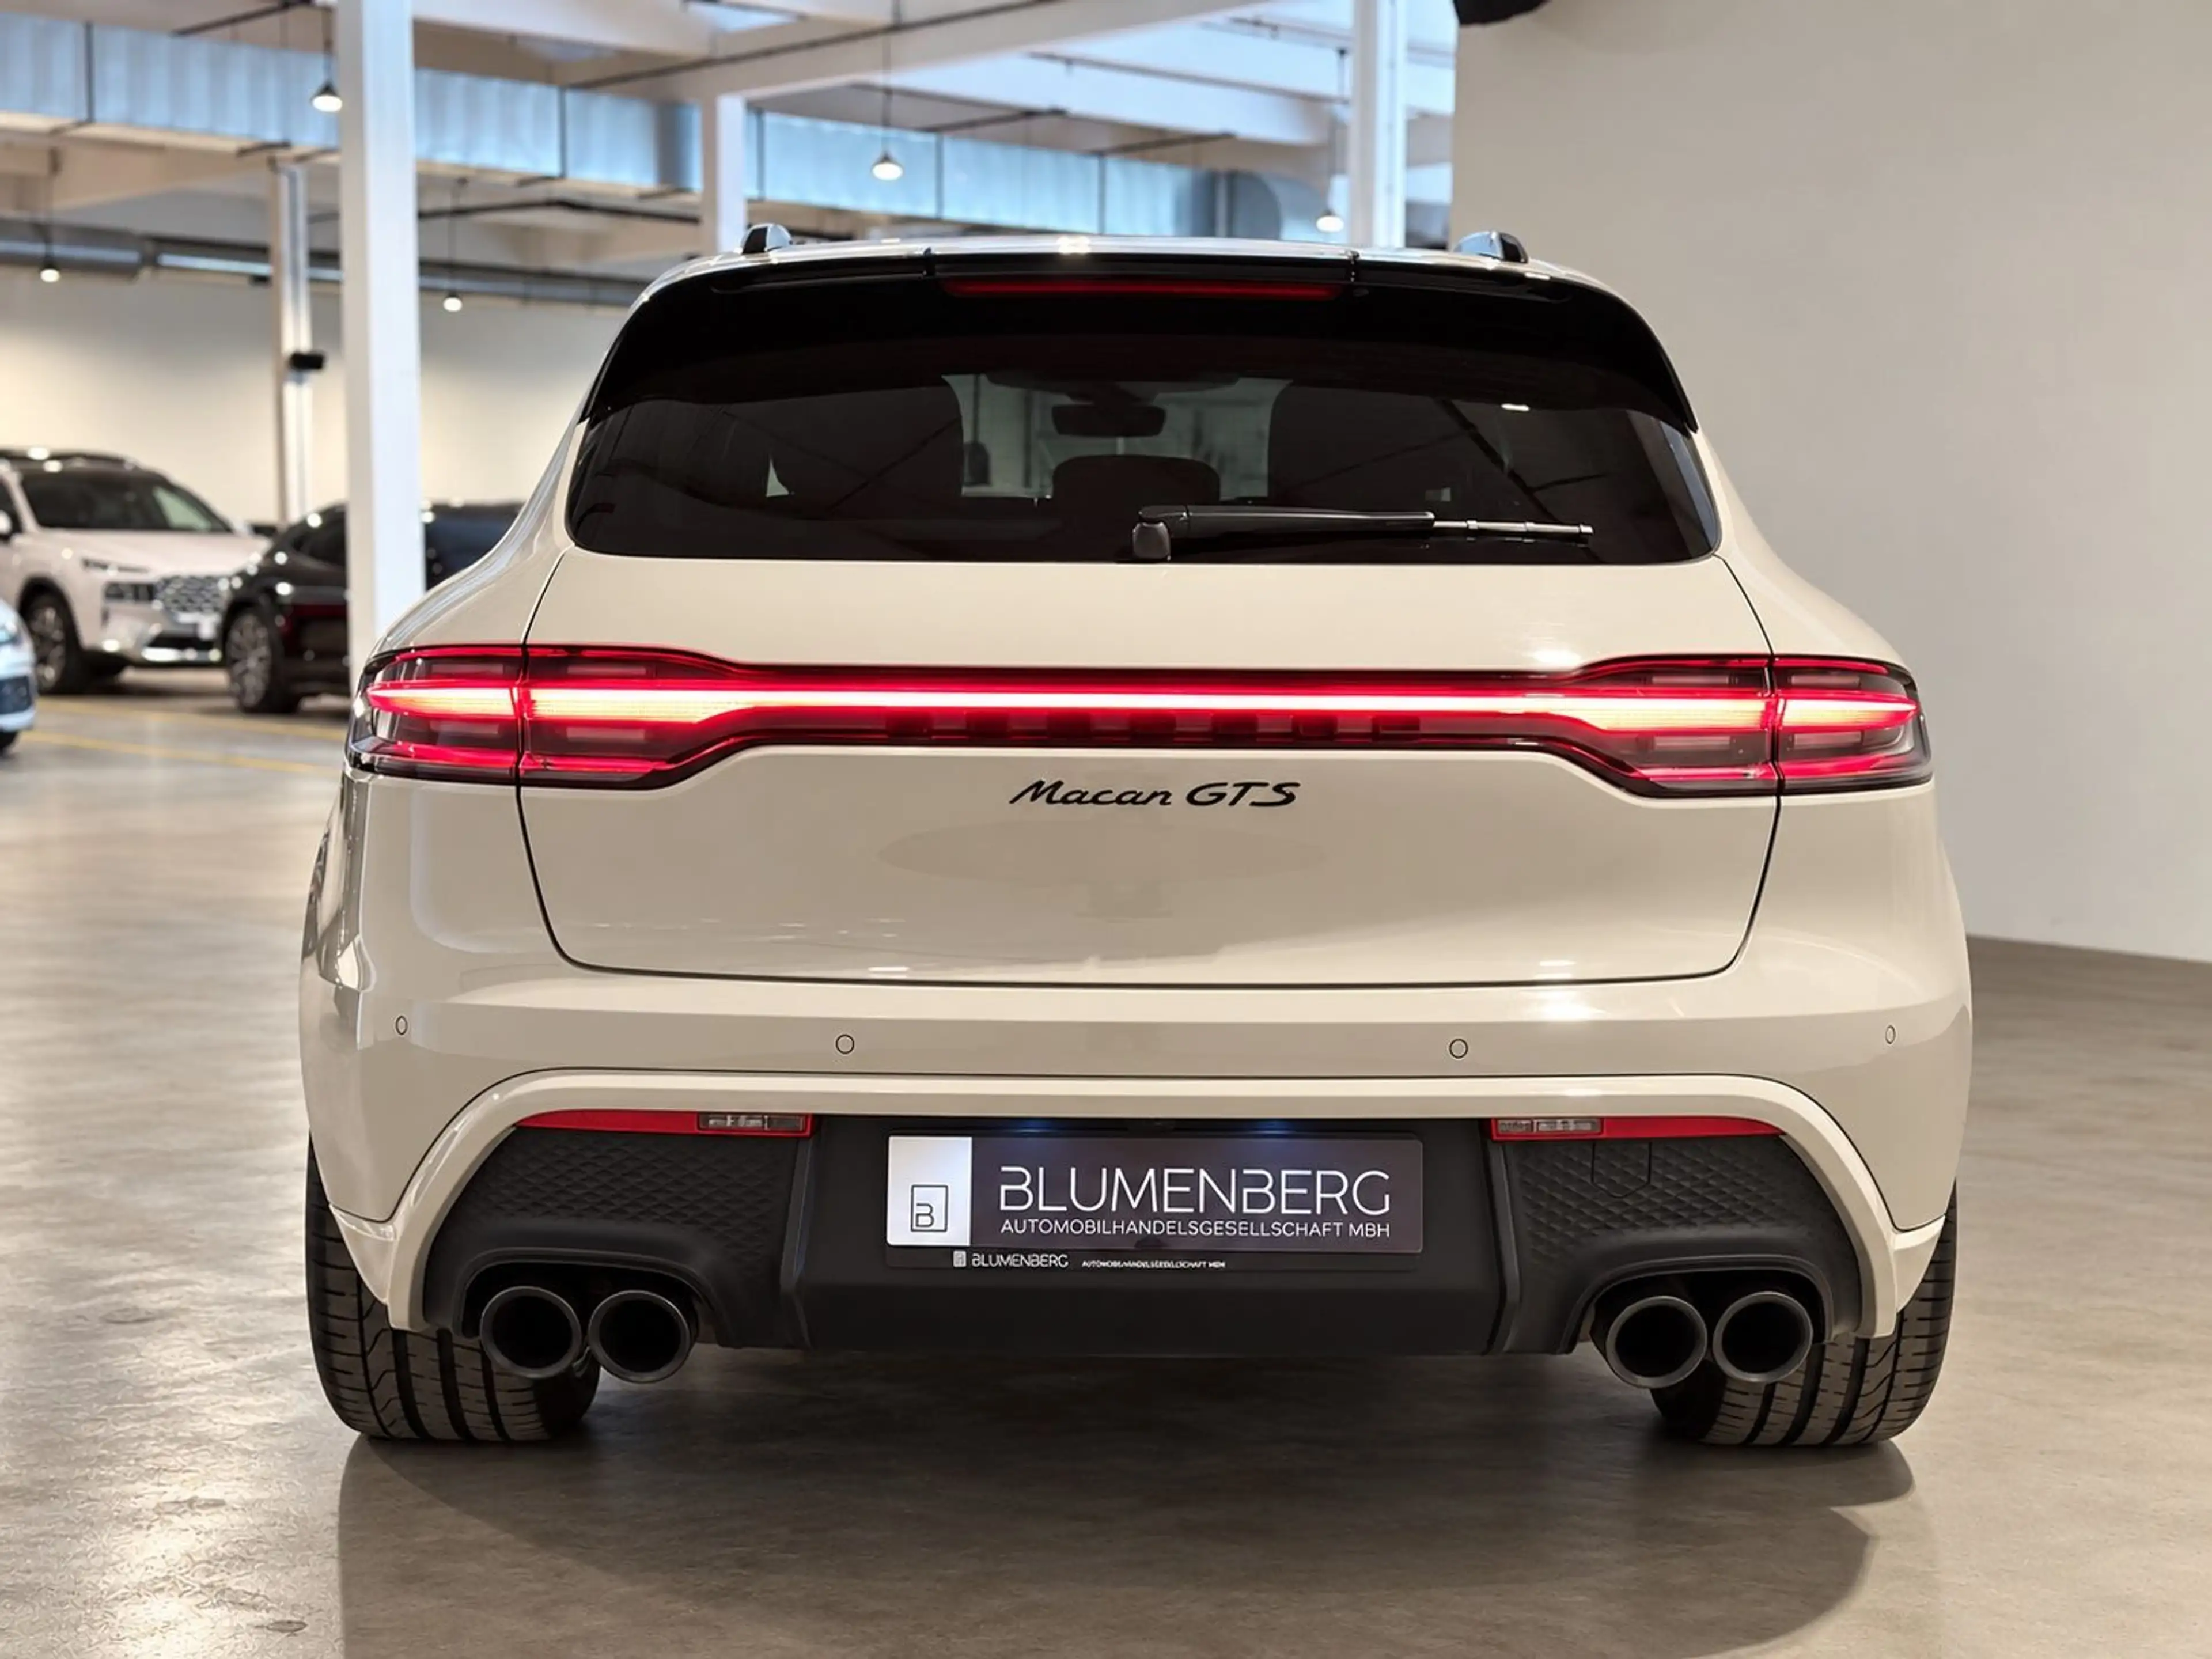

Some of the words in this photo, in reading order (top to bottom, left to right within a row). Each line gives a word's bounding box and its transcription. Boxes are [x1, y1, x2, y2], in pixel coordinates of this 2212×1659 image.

[1009, 779, 1172, 805] Macan
[1185, 781, 1301, 807] GTS
[1000, 1166, 1390, 1215] BLUMENBERG
[915, 1202, 934, 1228] B
[1000, 1218, 1343, 1237] AUTOMOBILHANDELSGESELLSCHAFT
[1348, 1222, 1390, 1237] MBH
[972, 1253, 1069, 1267] BLUMENBERG
